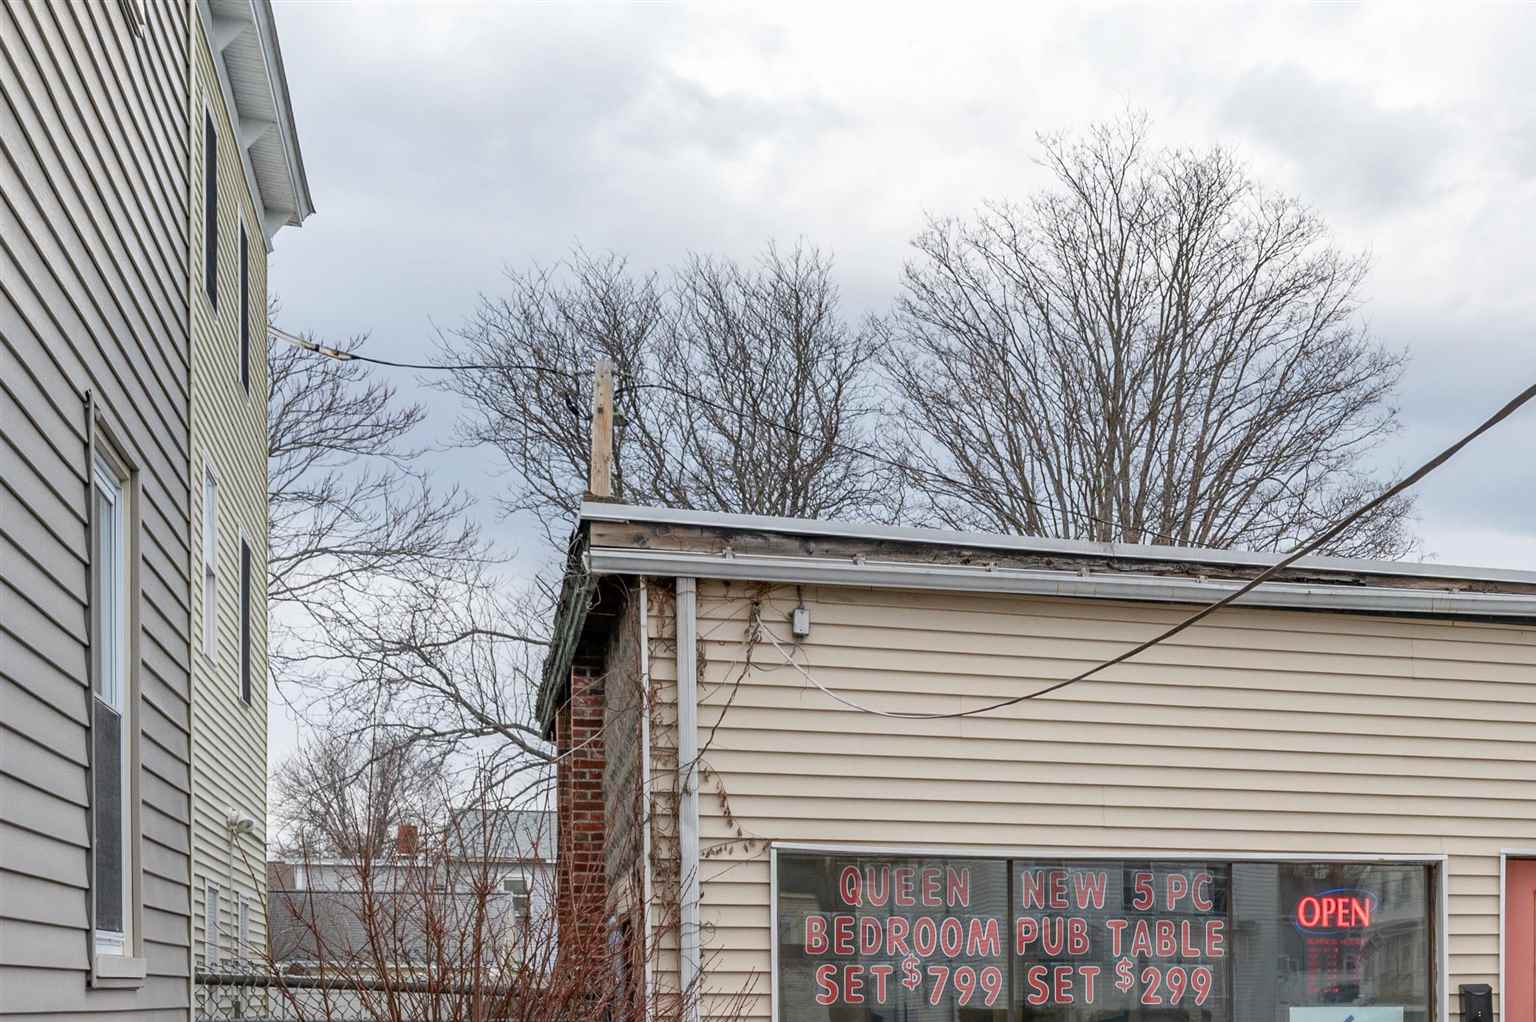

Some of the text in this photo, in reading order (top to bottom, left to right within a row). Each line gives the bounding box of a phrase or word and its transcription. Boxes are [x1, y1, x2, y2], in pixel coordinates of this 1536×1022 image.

[839, 864, 971, 907] QUEEN
[1022, 869, 1214, 912] NEW 5 PC
[1297, 896, 1371, 928] OPEN
[805, 914, 1000, 958] BEDROOM
[1016, 916, 1225, 958] PUB TABLE
[816, 953, 1002, 1006] SET $799
[1026, 956, 1213, 1006] SET $299
